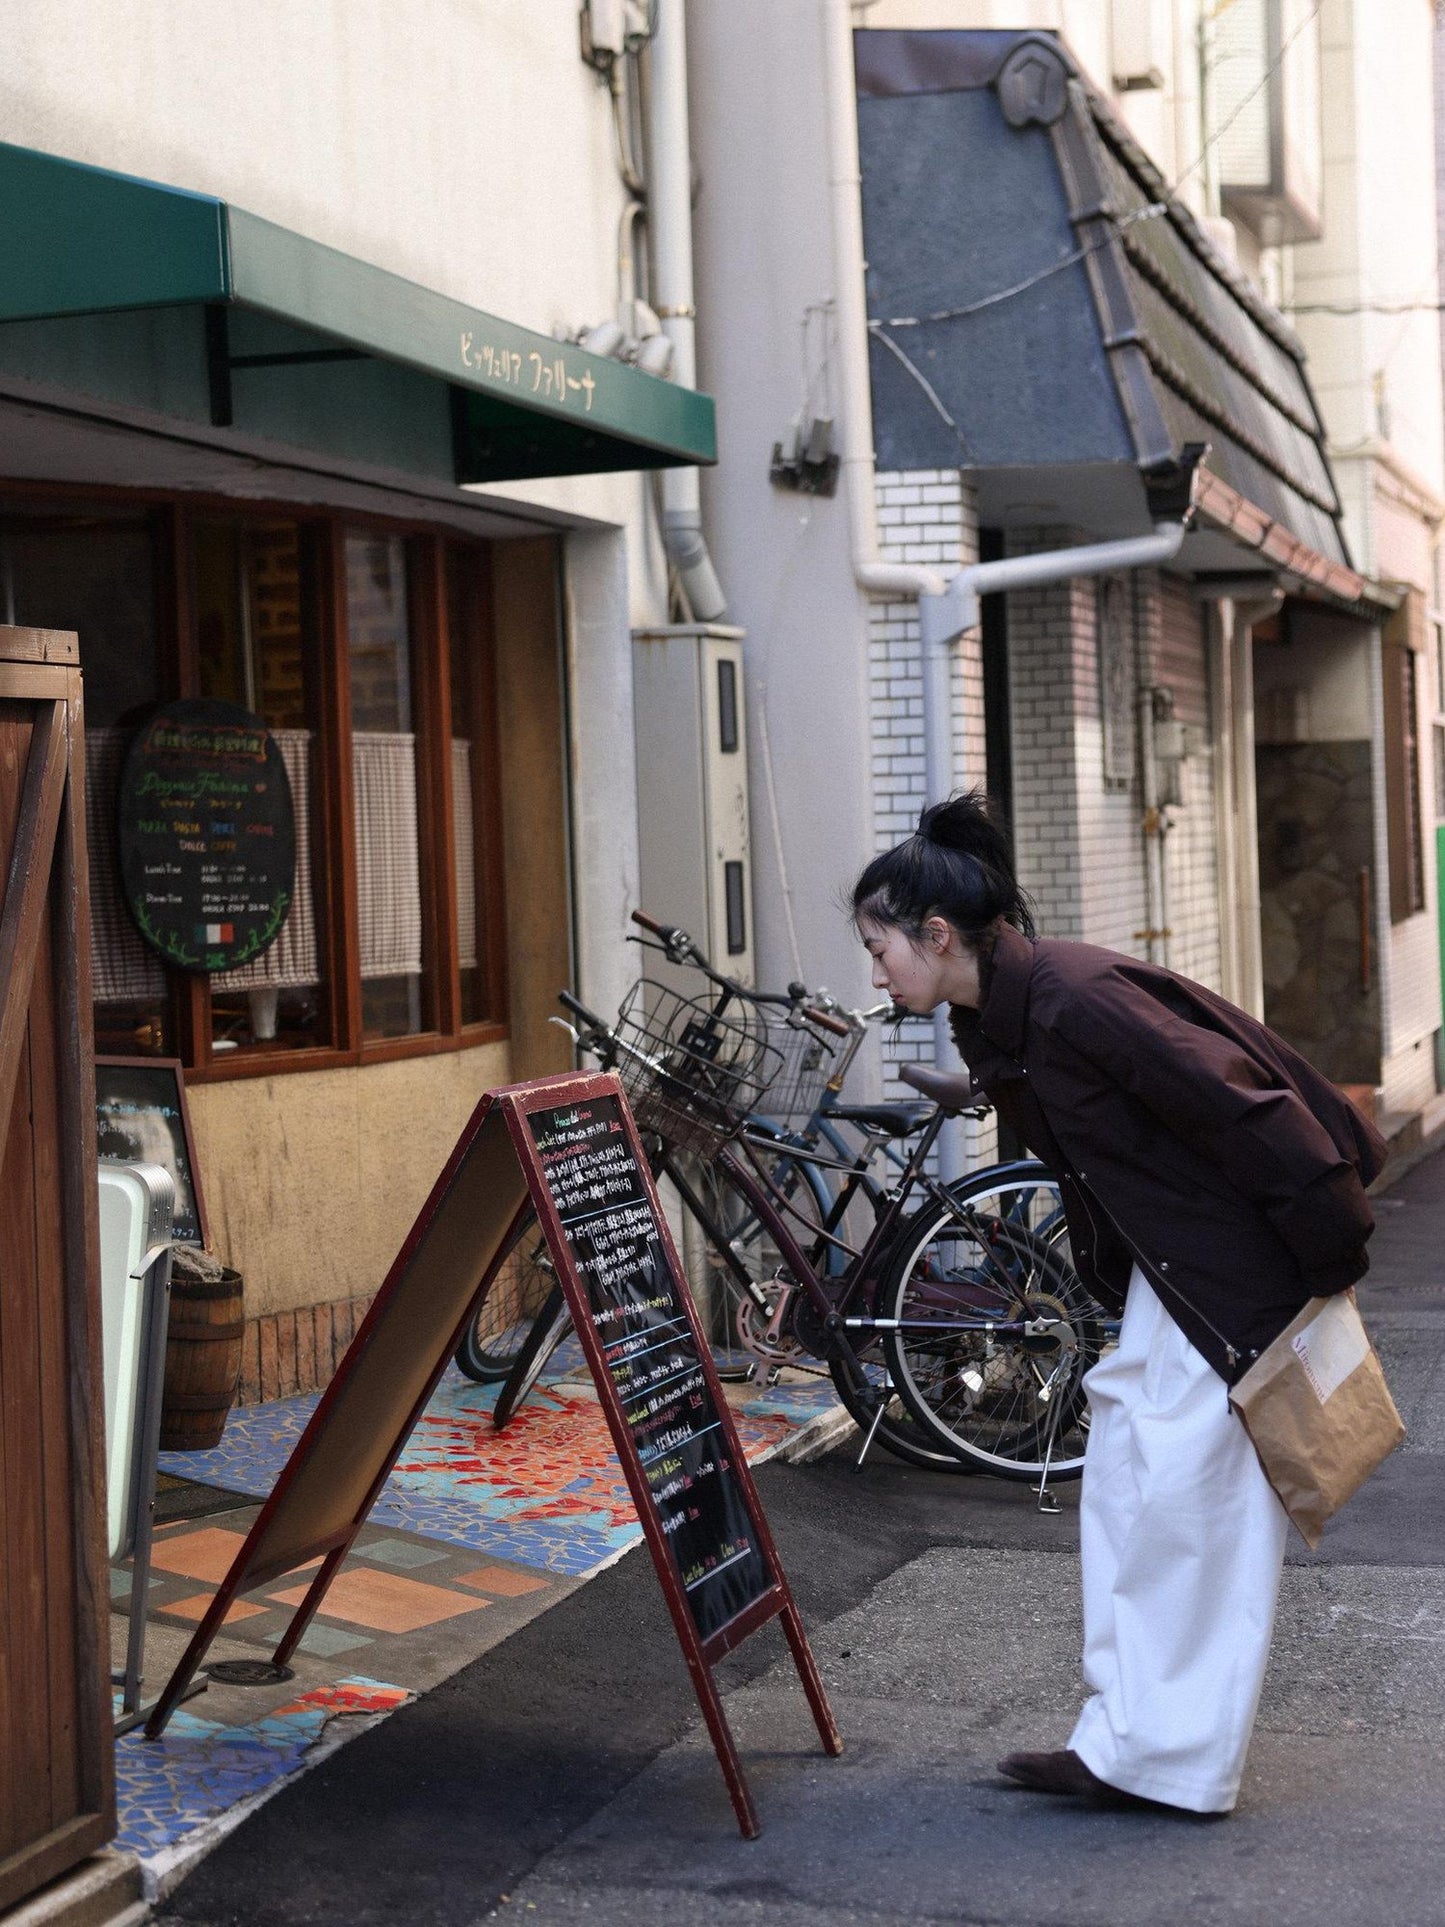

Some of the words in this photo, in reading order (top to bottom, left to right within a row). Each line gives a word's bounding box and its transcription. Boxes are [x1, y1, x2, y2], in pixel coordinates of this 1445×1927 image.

[460, 331, 522, 385] ピッツェリア
[528, 351, 596, 411] ファリーナ
